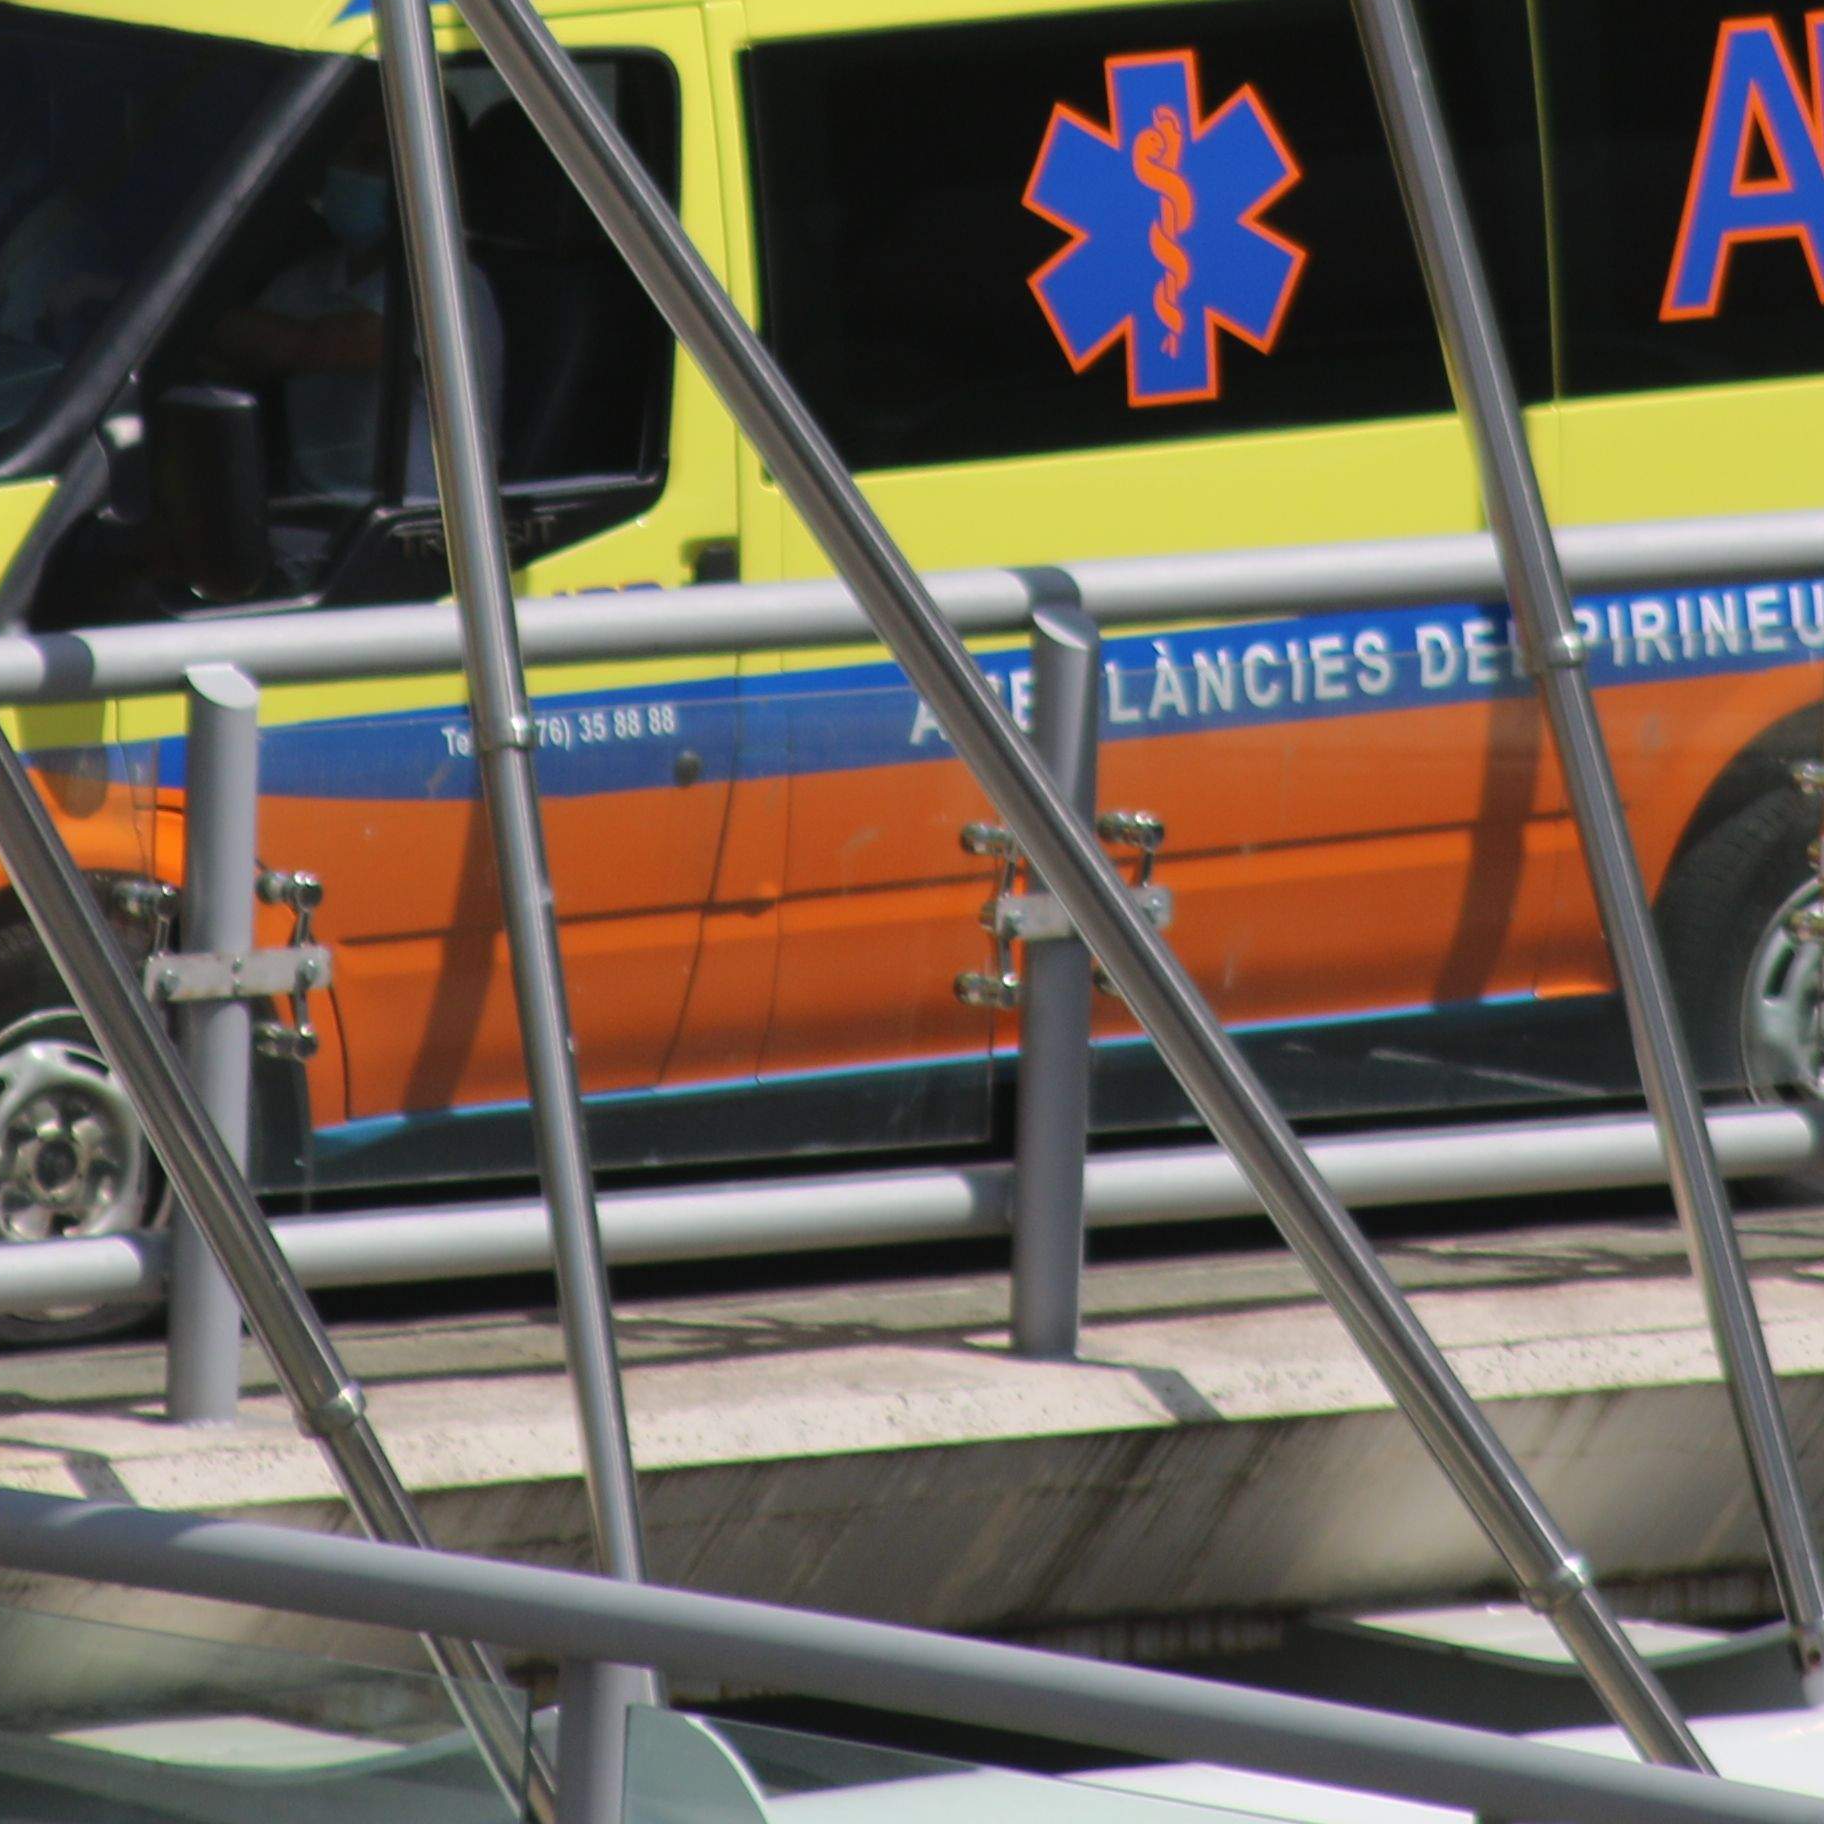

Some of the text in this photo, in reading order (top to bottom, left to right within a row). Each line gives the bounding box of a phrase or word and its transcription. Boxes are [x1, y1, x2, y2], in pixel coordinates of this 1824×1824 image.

[579, 712, 608, 743] 35
[613, 708, 642, 739] 88
[647, 704, 677, 734] 88
